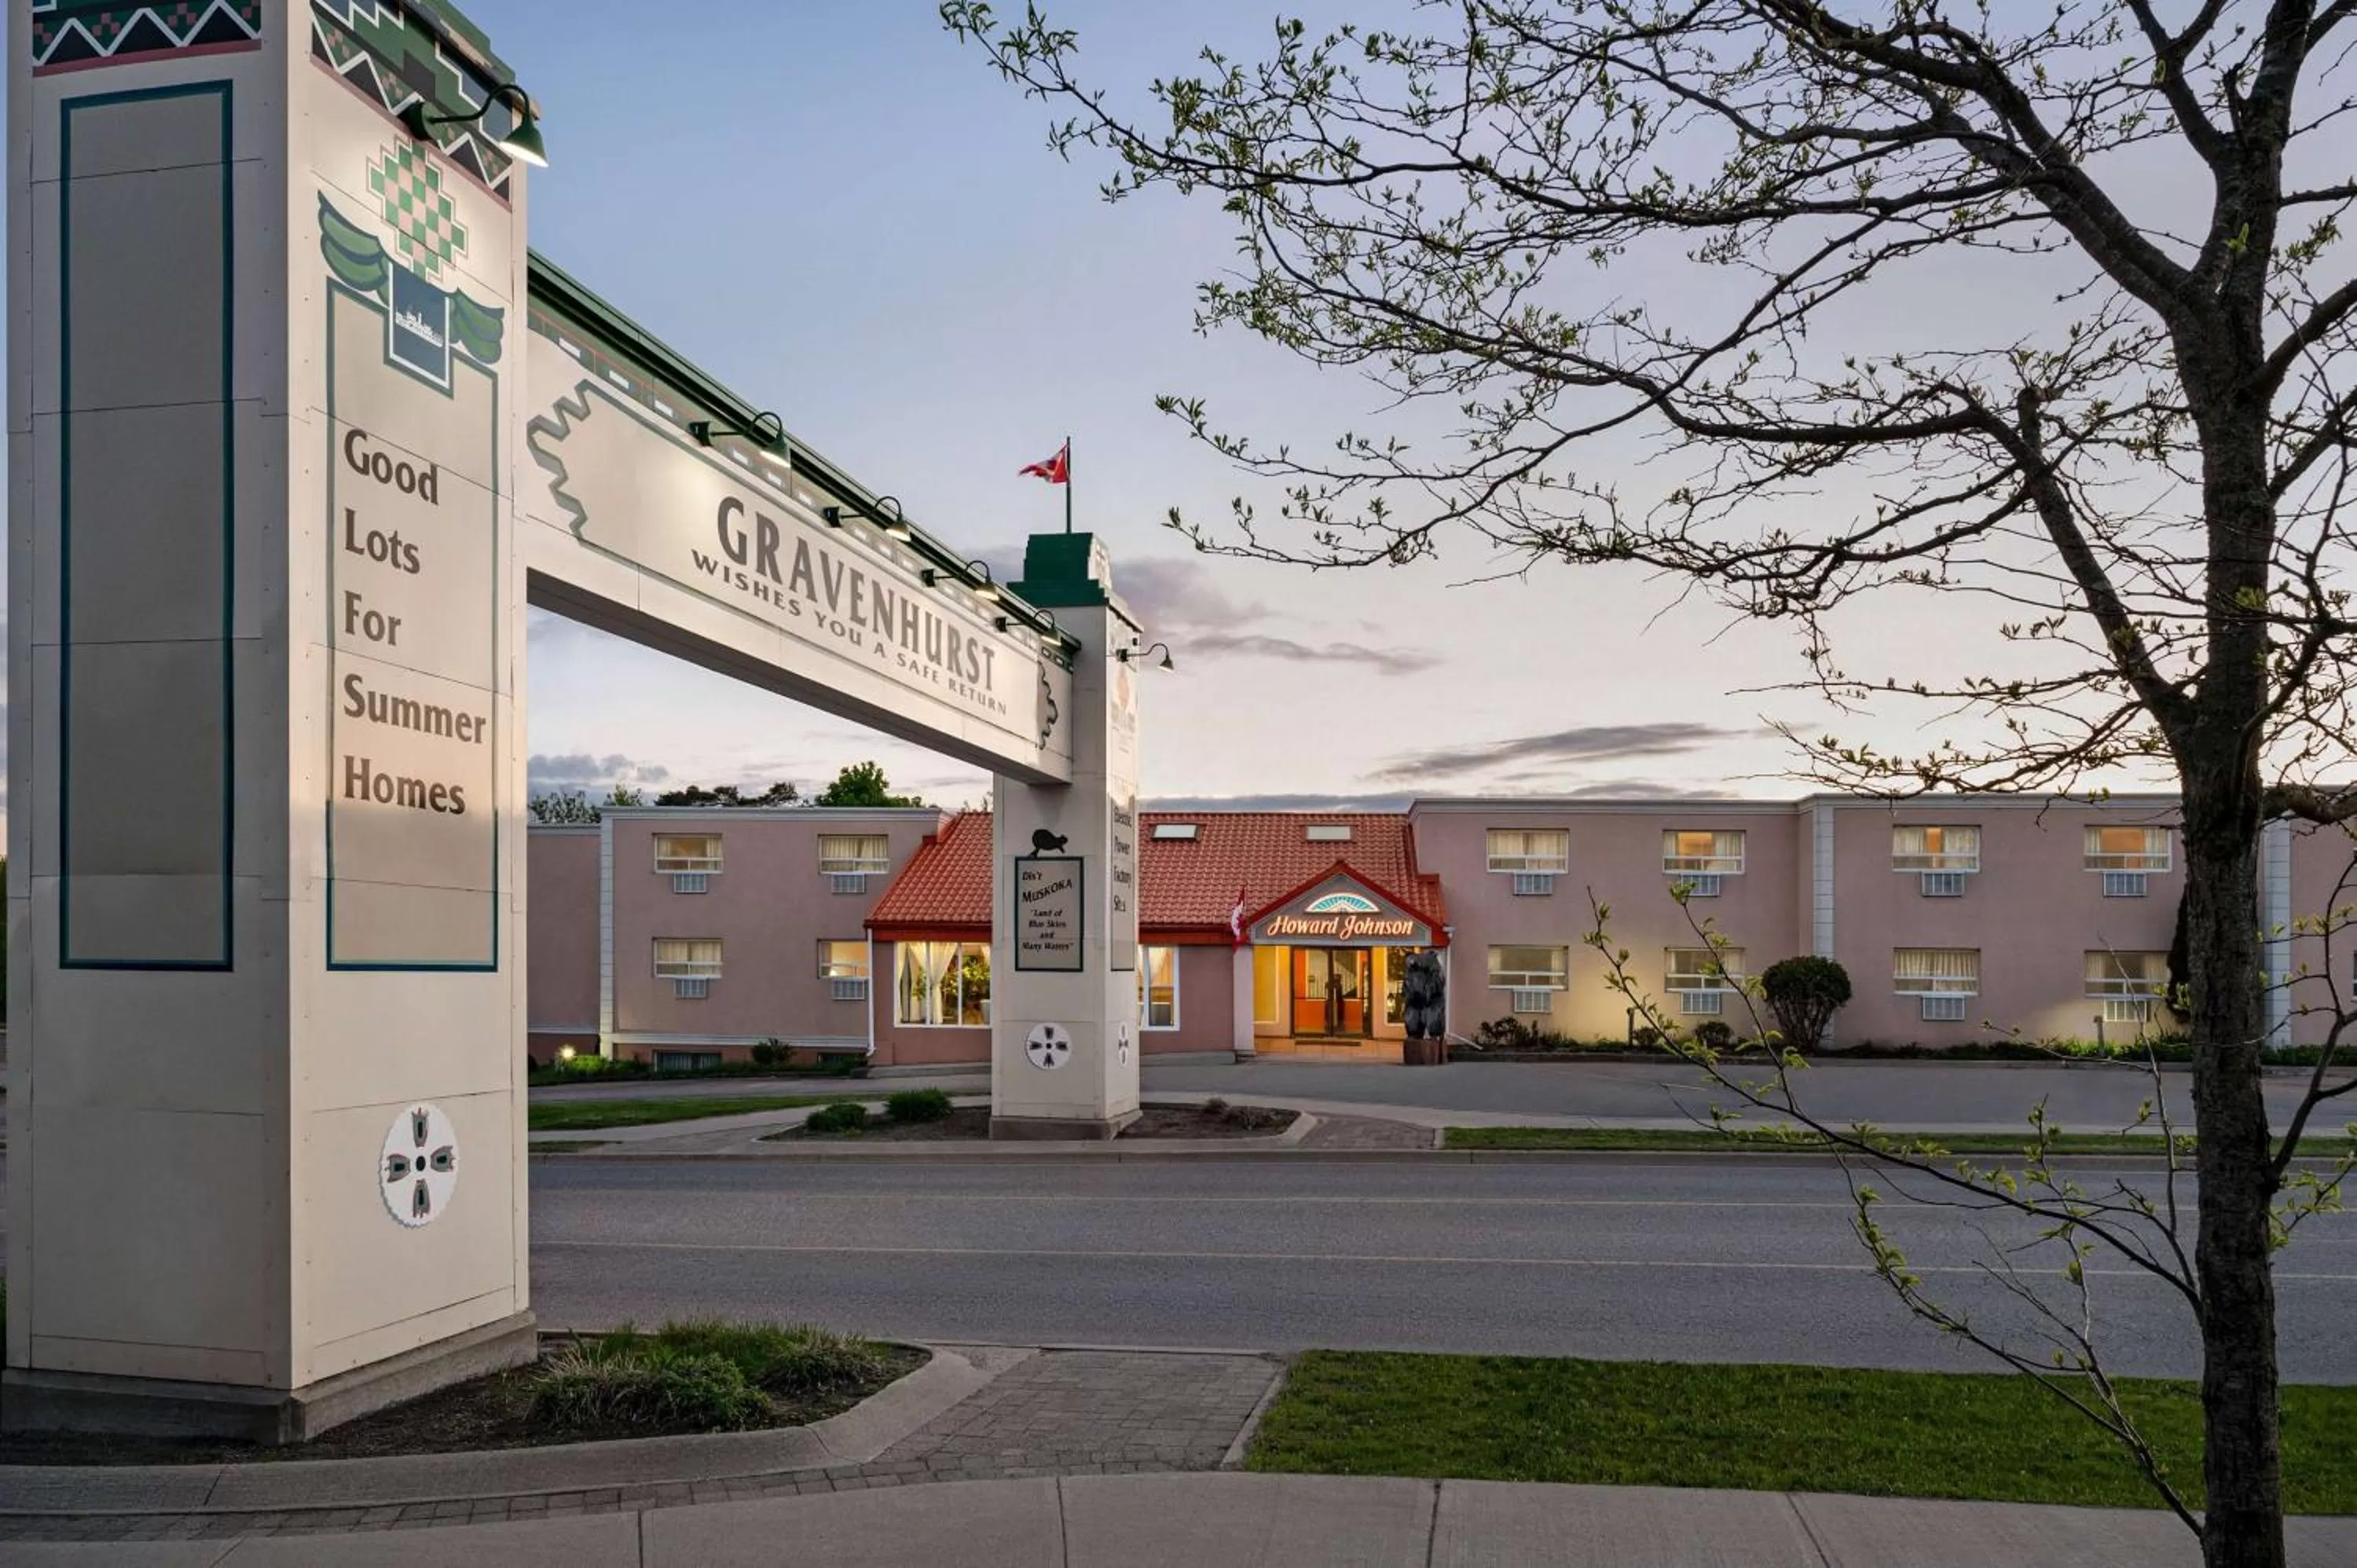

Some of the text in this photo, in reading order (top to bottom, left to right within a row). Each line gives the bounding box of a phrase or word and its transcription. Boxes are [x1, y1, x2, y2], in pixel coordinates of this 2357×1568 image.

[344, 428, 438, 505] Good
[344, 508, 420, 574] Lots
[344, 590, 401, 646] For
[717, 496, 995, 692] GRAVENHURST
[691, 549, 1006, 715] WISHES YOU A SAFE RETURN
[344, 673, 486, 743] Summer
[344, 754, 466, 815] Homes
[1022, 878, 1072, 903] MUSKOKA
[1054, 908, 1063, 917] of
[1022, 942, 1042, 952] Many
[1267, 915, 1413, 940] Howard Johnson
